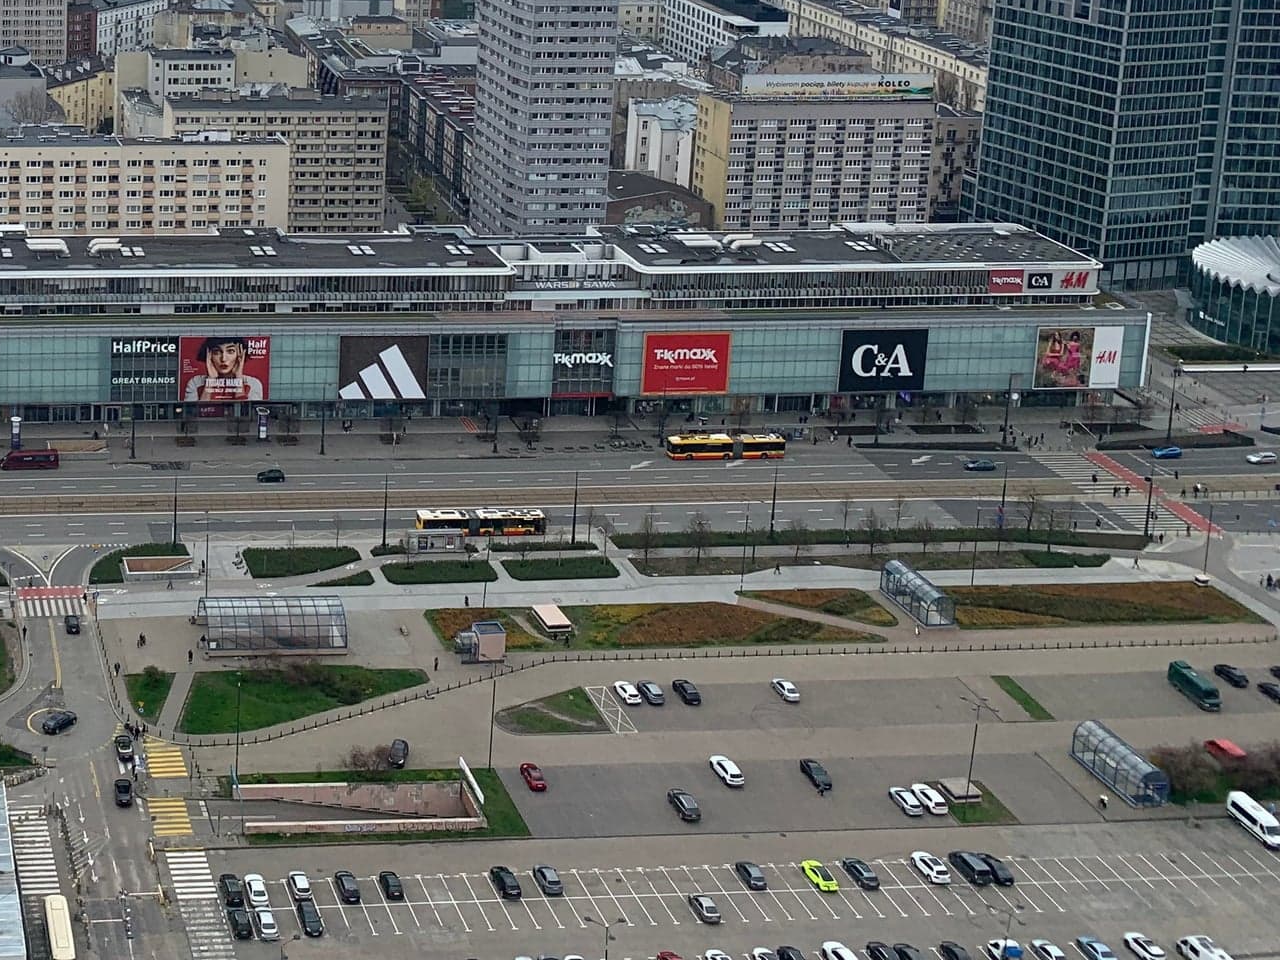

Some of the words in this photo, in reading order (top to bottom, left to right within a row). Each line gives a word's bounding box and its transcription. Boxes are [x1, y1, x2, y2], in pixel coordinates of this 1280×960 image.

[583, 281, 617, 289] SAWA
[112, 340, 177, 353] HalfPrice
[247, 340, 267, 348] Half
[247, 347, 267, 355] Price
[851, 344, 913, 377] C&A
[141, 376, 176, 384] BRANDS
